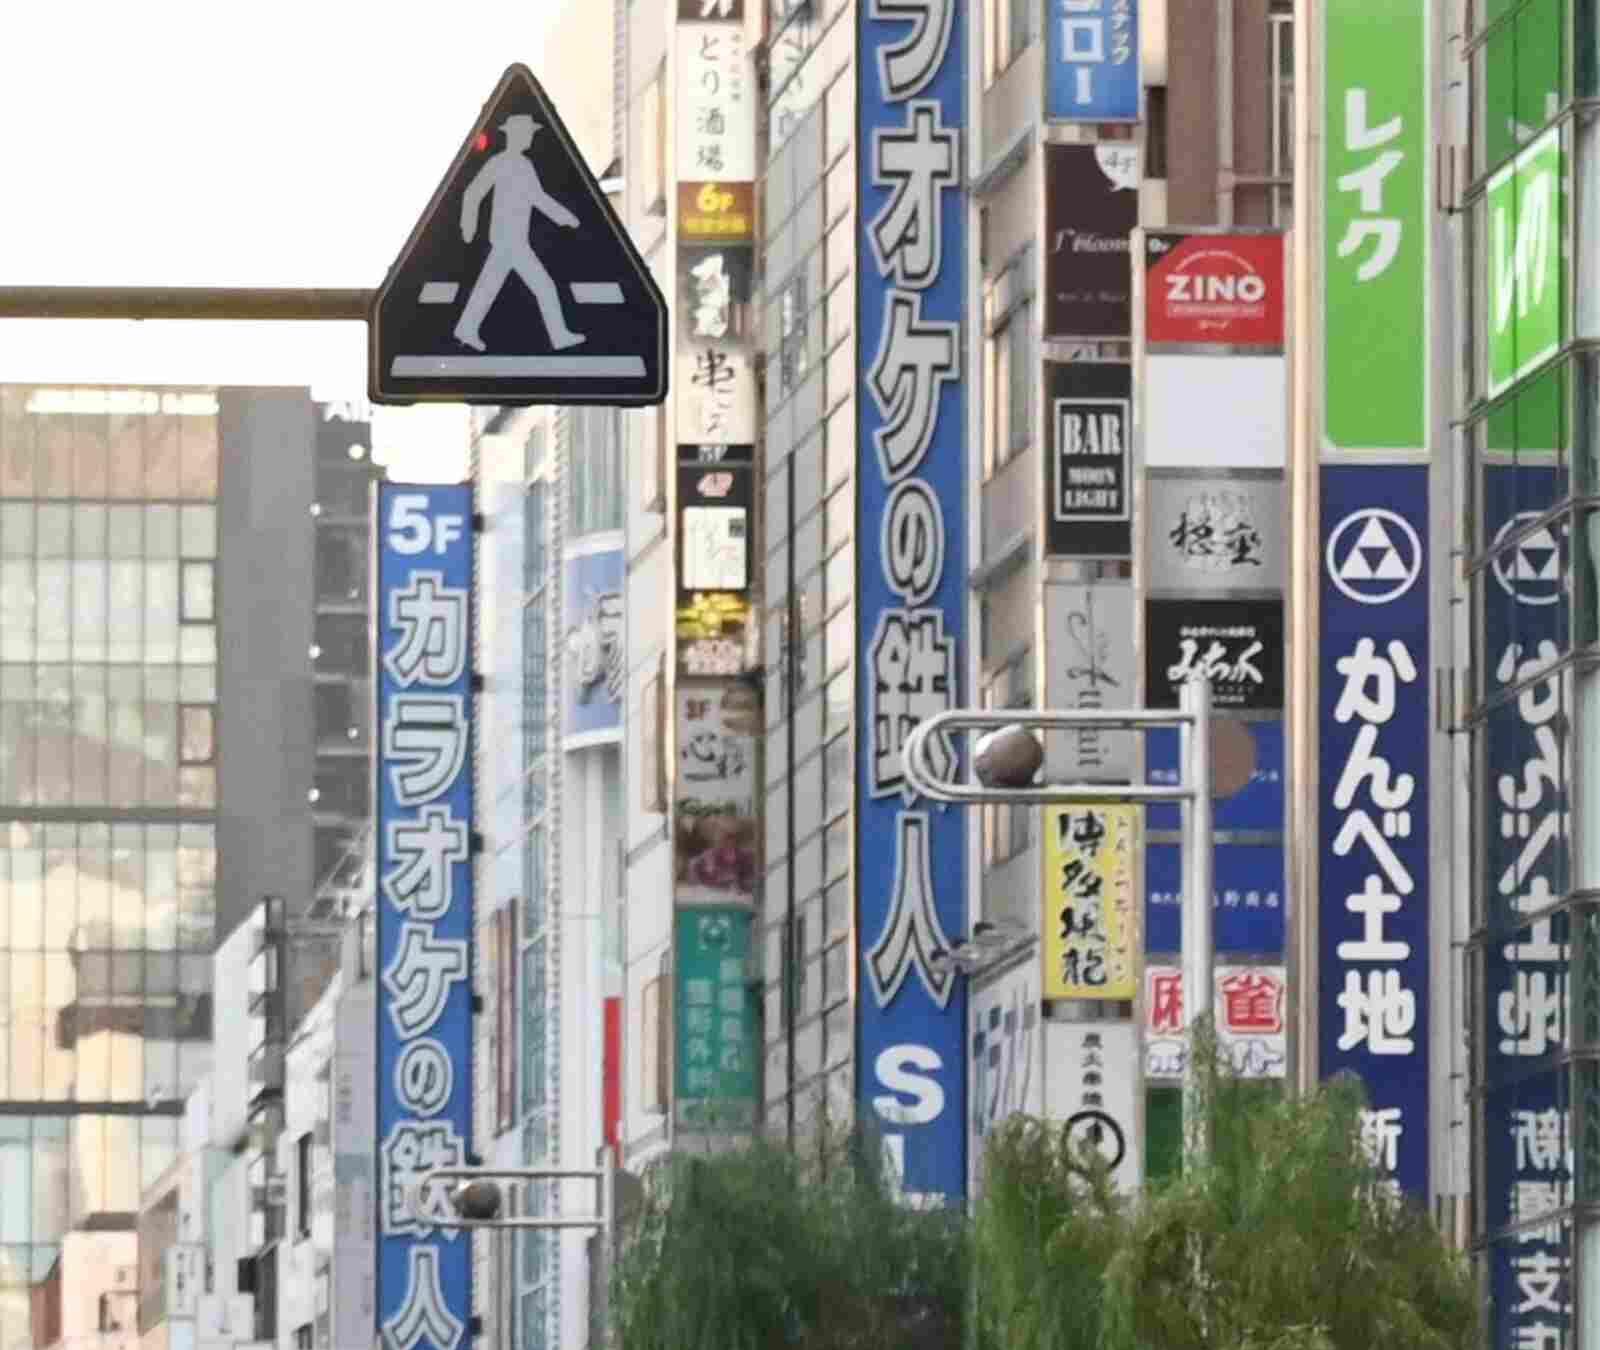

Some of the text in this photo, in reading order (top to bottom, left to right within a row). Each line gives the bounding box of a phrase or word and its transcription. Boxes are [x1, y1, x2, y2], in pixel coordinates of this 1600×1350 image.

[1061, 0, 1106, 105] ロー
[1337, 88, 1405, 282] レイク
[1165, 274, 1266, 303] ZINO
[1063, 413, 1121, 455] BAR
[388, 494, 464, 555] 5F
[1065, 489, 1120, 509] LIGHT
[1333, 634, 1419, 1054] かんべ土地
